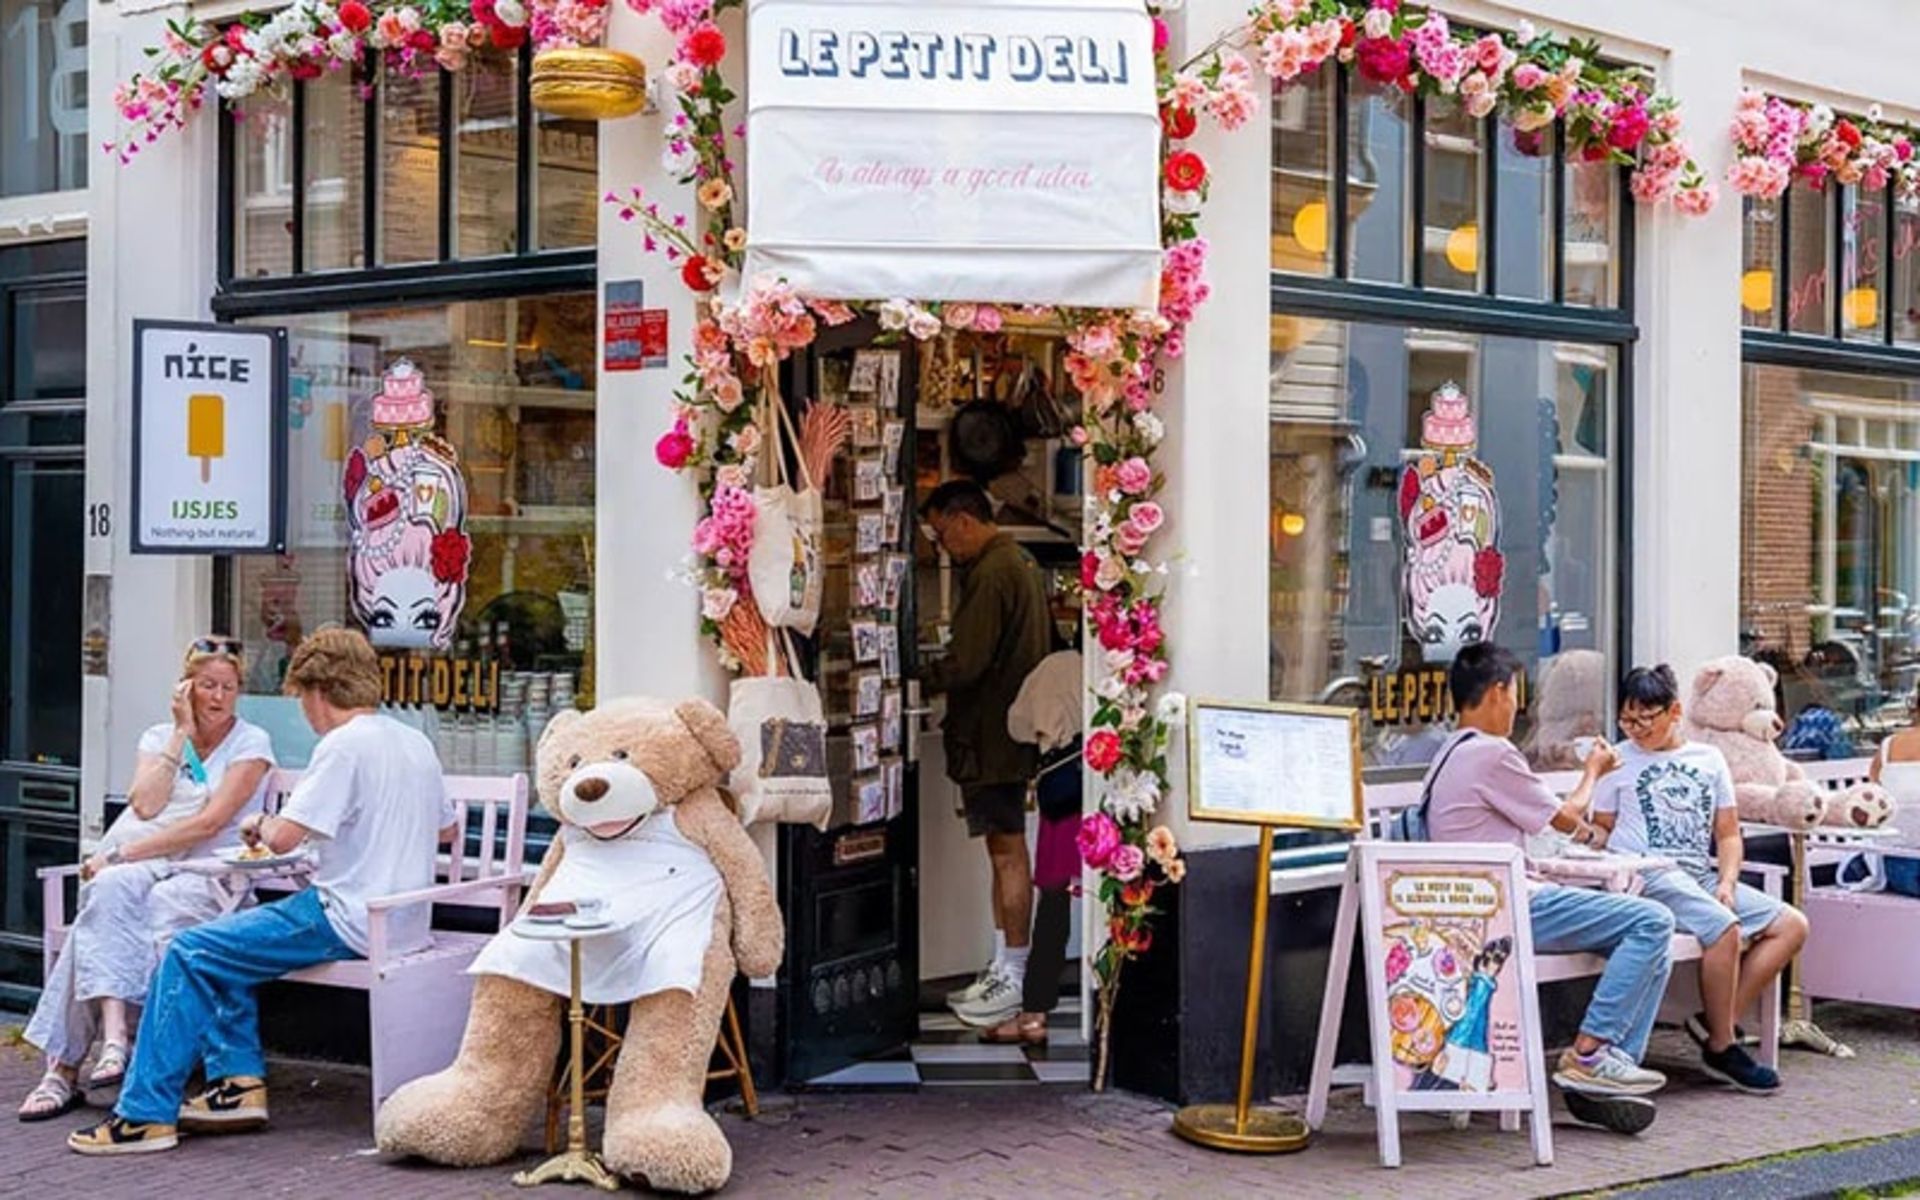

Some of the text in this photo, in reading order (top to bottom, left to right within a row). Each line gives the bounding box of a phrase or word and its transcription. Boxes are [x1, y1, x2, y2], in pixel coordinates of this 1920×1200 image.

[780, 28, 1129, 84] LE PETIT DELI
[853, 161, 932, 190] always
[942, 167, 959, 185] a
[967, 163, 1034, 195] good
[1036, 163, 1090, 188] idea
[89, 503, 110, 537] 18
[172, 500, 238, 519] IJSJES
[151, 527, 195, 541] Nothing
[199, 527, 216, 540] but
[379, 655, 500, 715] TIT DELI
[1371, 674, 1399, 726] LE
[1403, 670, 1456, 723] PET
